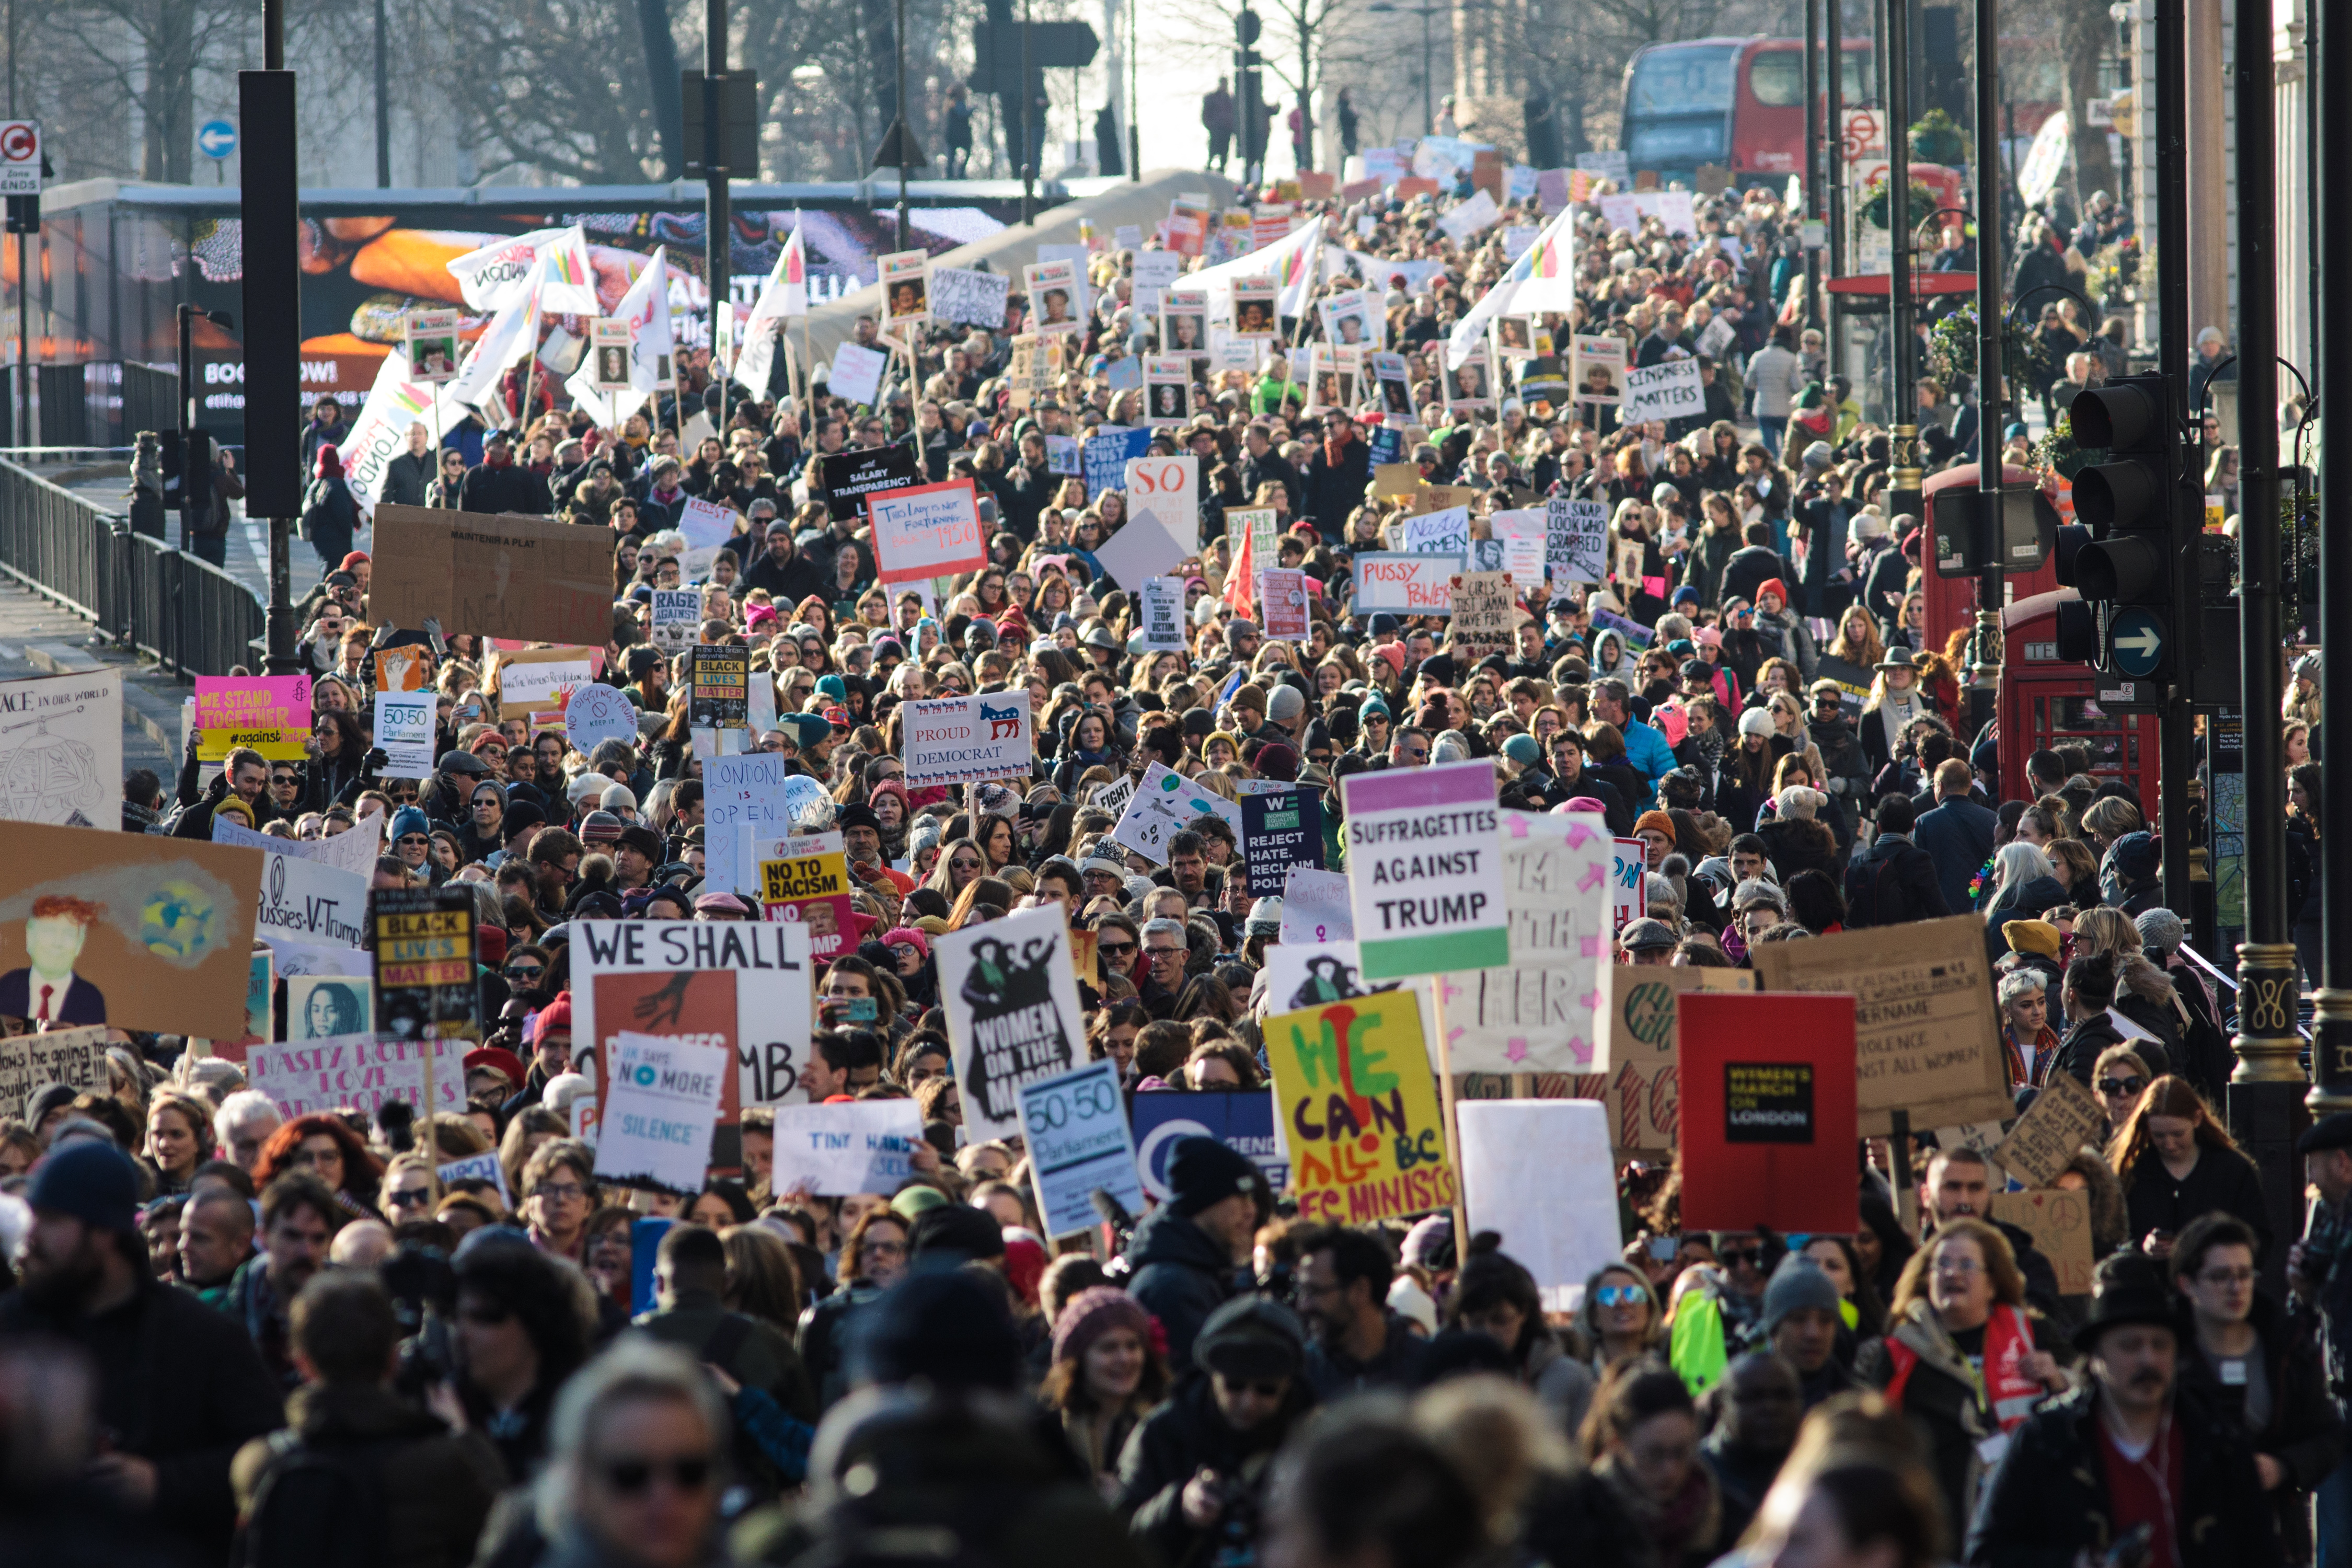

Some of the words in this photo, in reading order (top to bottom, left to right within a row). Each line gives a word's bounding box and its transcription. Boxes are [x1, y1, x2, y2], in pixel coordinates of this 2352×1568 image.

[1, 180, 36, 189] ENDS
[1628, 362, 1695, 388] KINDNESS
[1634, 386, 1697, 406] MATTERS
[1085, 433, 1128, 449] GIRLS
[1085, 446, 1126, 463] JUST
[849, 468, 888, 483] SALARY
[1135, 463, 1184, 494] SO
[833, 476, 911, 497] TRANSPARENCY
[689, 500, 730, 520] RESIST
[942, 500, 959, 511] NOT
[1549, 501, 1567, 514] OH
[1408, 513, 1463, 539] Nasty
[1548, 516, 1580, 533] LOOK
[1582, 518, 1606, 534] WHO
[451, 531, 501, 545] MAINTENIR
[512, 539, 536, 548] PLAT
[917, 528, 933, 539] TO
[935, 522, 975, 548] 1950
[1548, 533, 1601, 552] GRABBED
[1364, 563, 1421, 585] PUSSY
[1405, 580, 1451, 608] POWER
[1468, 580, 1497, 597] GIRLS
[655, 592, 697, 609] RAGE
[655, 608, 697, 620] AGAINST
[1154, 612, 1171, 621] STOP
[1459, 613, 1481, 627] HAVE
[1152, 622, 1175, 632] VICTIM
[701, 661, 739, 671] BLACK
[703, 674, 736, 684] LIVES
[39, 696, 49, 706] IN
[52, 694, 71, 705] OUR
[75, 688, 108, 701] WORLD
[199, 693, 220, 708] WE
[224, 690, 272, 708] STAND
[697, 687, 743, 697] MATTER
[200, 707, 290, 729] TOGETHER
[384, 709, 426, 725] 50:50
[568, 715, 577, 730] NO
[575, 689, 612, 709] DIGGING
[615, 696, 635, 726] TRUMP
[383, 725, 426, 739] Parliament
[916, 727, 970, 742] PROUD
[916, 746, 1002, 765] DEMOCRAT
[709, 759, 777, 788] LONDON
[739, 791, 751, 801] IS
[1100, 781, 1131, 809] FIGHT
[712, 804, 774, 826] OPEN
[787, 795, 831, 822] EMINIST
[1267, 816, 1296, 824] EQUALITY
[1351, 809, 1498, 847] SUFFRAGETTES
[790, 840, 811, 848] STAND
[1249, 832, 1304, 847] REJECT
[801, 845, 825, 854] RACISM
[1250, 848, 1293, 861] HATE.
[766, 862, 793, 881] NO
[796, 859, 822, 877] TO
[1251, 859, 1314, 876] RECLAIM
[1373, 850, 1480, 885] AGAINST
[768, 874, 838, 900] RACISM
[771, 904, 798, 923] NO
[1376, 892, 1488, 930] TRUMP
[388, 915, 458, 933] BLACK
[394, 938, 455, 961] LIVES
[583, 923, 644, 965] WE
[660, 925, 800, 971] SHALL
[385, 962, 466, 983] MATTER
[1479, 967, 1575, 1027] HER
[975, 1000, 1059, 1055] WOMEN
[29, 1041, 47, 1066] he
[51, 1044, 90, 1068] going
[92, 1039, 105, 1056] to
[256, 1045, 343, 1076] NASTY
[622, 1046, 638, 1060] UK
[643, 1048, 672, 1064] SAYS
[1018, 1035, 1063, 1068] THE
[1925, 1046, 1981, 1070] WOMEN
[984, 1048, 1016, 1078] ON
[319, 1066, 386, 1093] LOVE
[618, 1063, 656, 1086] NO
[661, 1069, 716, 1097] MORE
[1730, 1082, 1796, 1096] MARCH
[1026, 1079, 1116, 1134] 50:50
[1294, 1088, 1406, 1140] CAN
[1730, 1110, 1807, 1126] LONDON
[810, 1132, 851, 1149] TINY
[1033, 1126, 1123, 1163] Parliament
[1299, 1145, 1381, 1189] ALL
